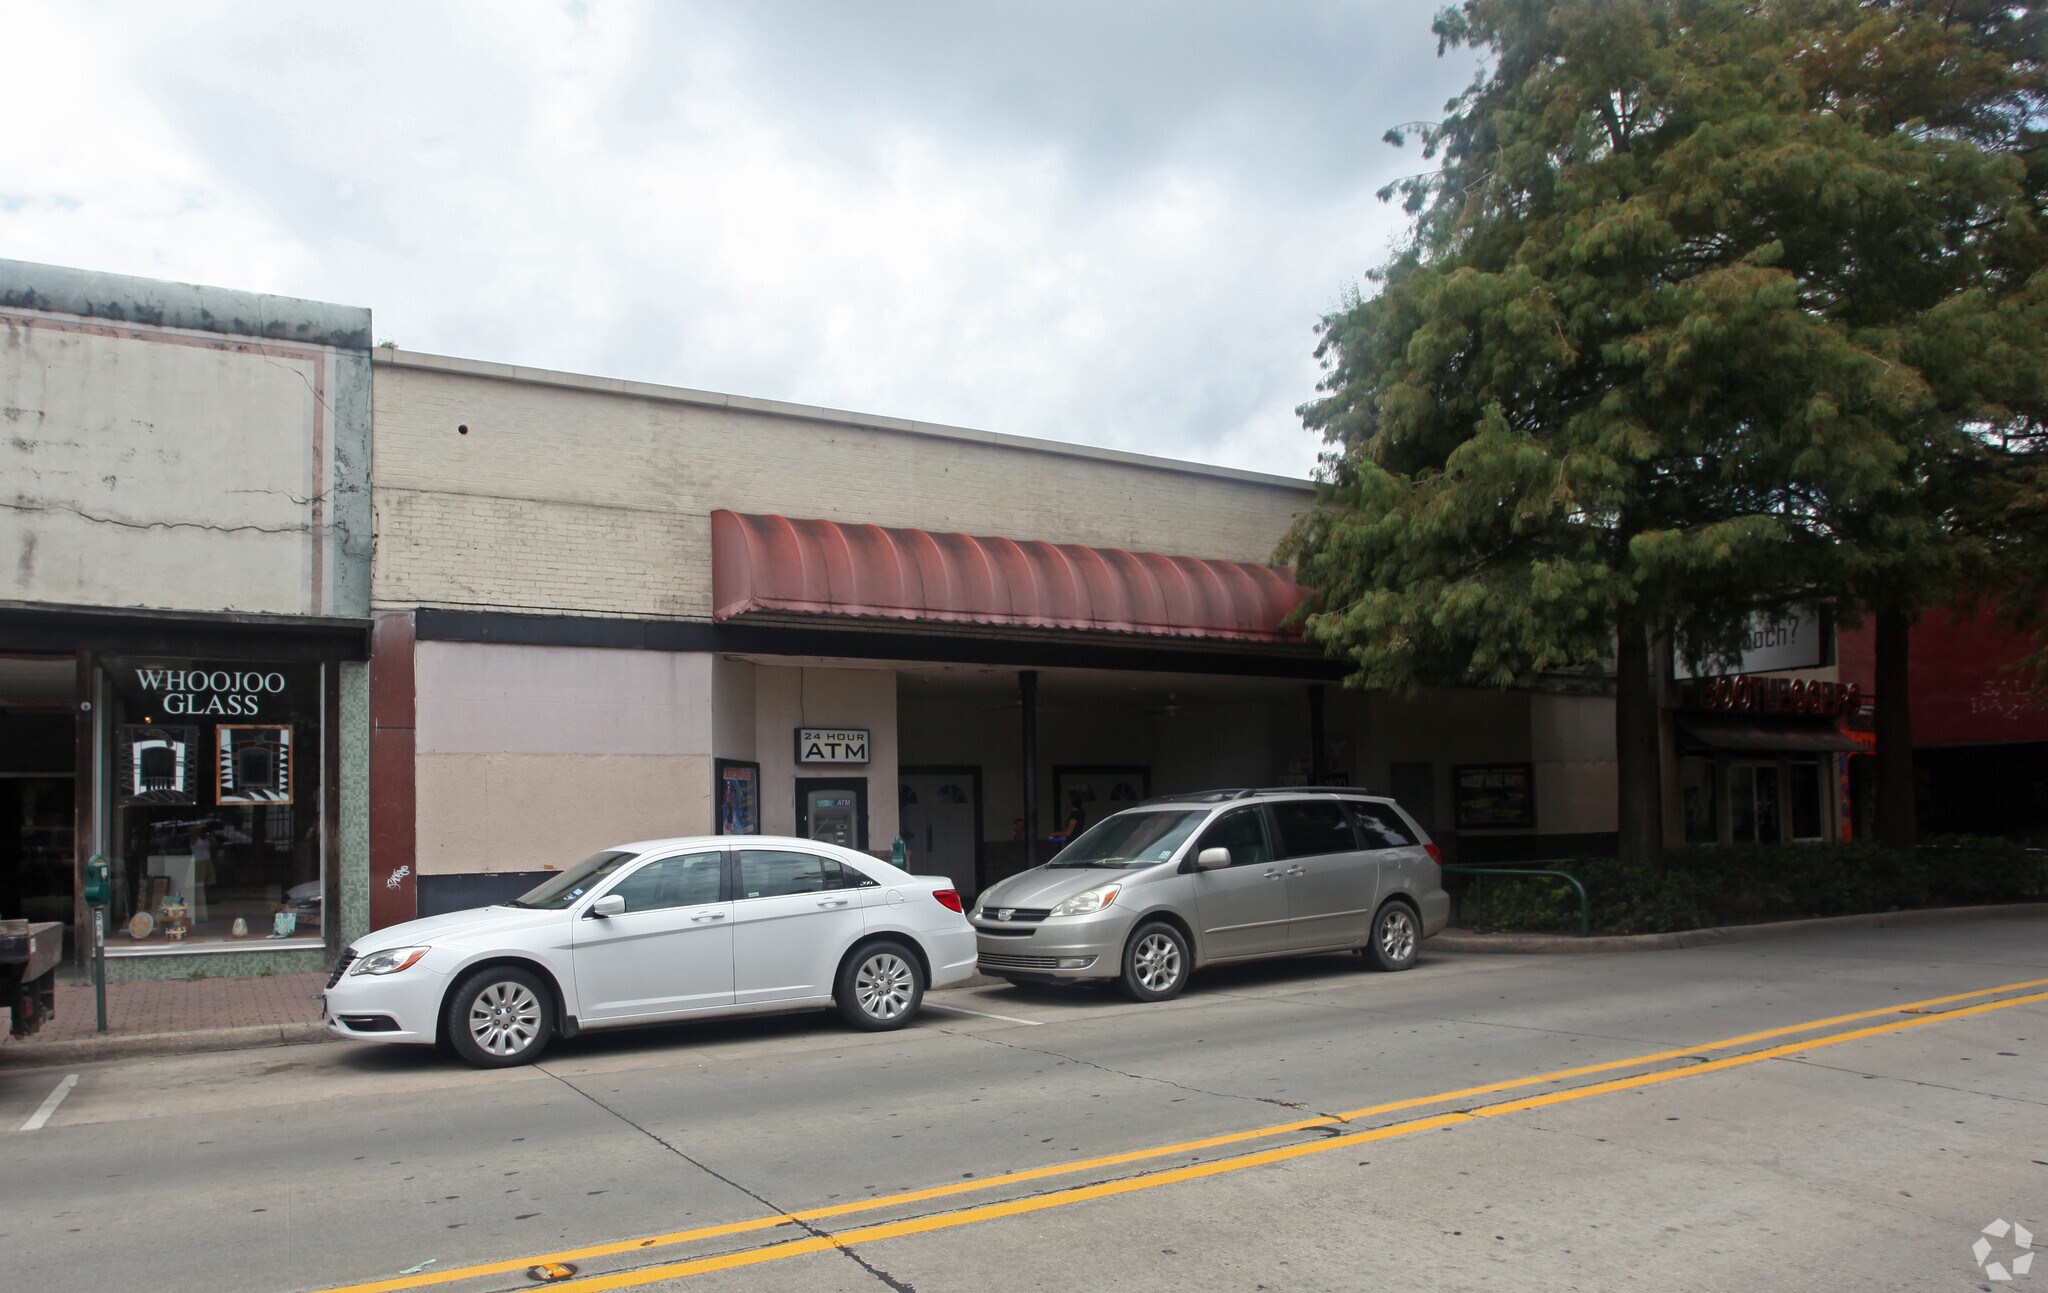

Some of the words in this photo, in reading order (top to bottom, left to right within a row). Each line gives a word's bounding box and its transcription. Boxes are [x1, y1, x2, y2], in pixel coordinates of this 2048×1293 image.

[135, 668, 285, 693] WHOOJOO
[163, 693, 259, 715] GLASS
[1701, 674, 1861, 716] BOOTLEGGERS
[804, 732, 821, 741] 24
[827, 733, 865, 741] HOUR
[805, 742, 865, 760] ATM
